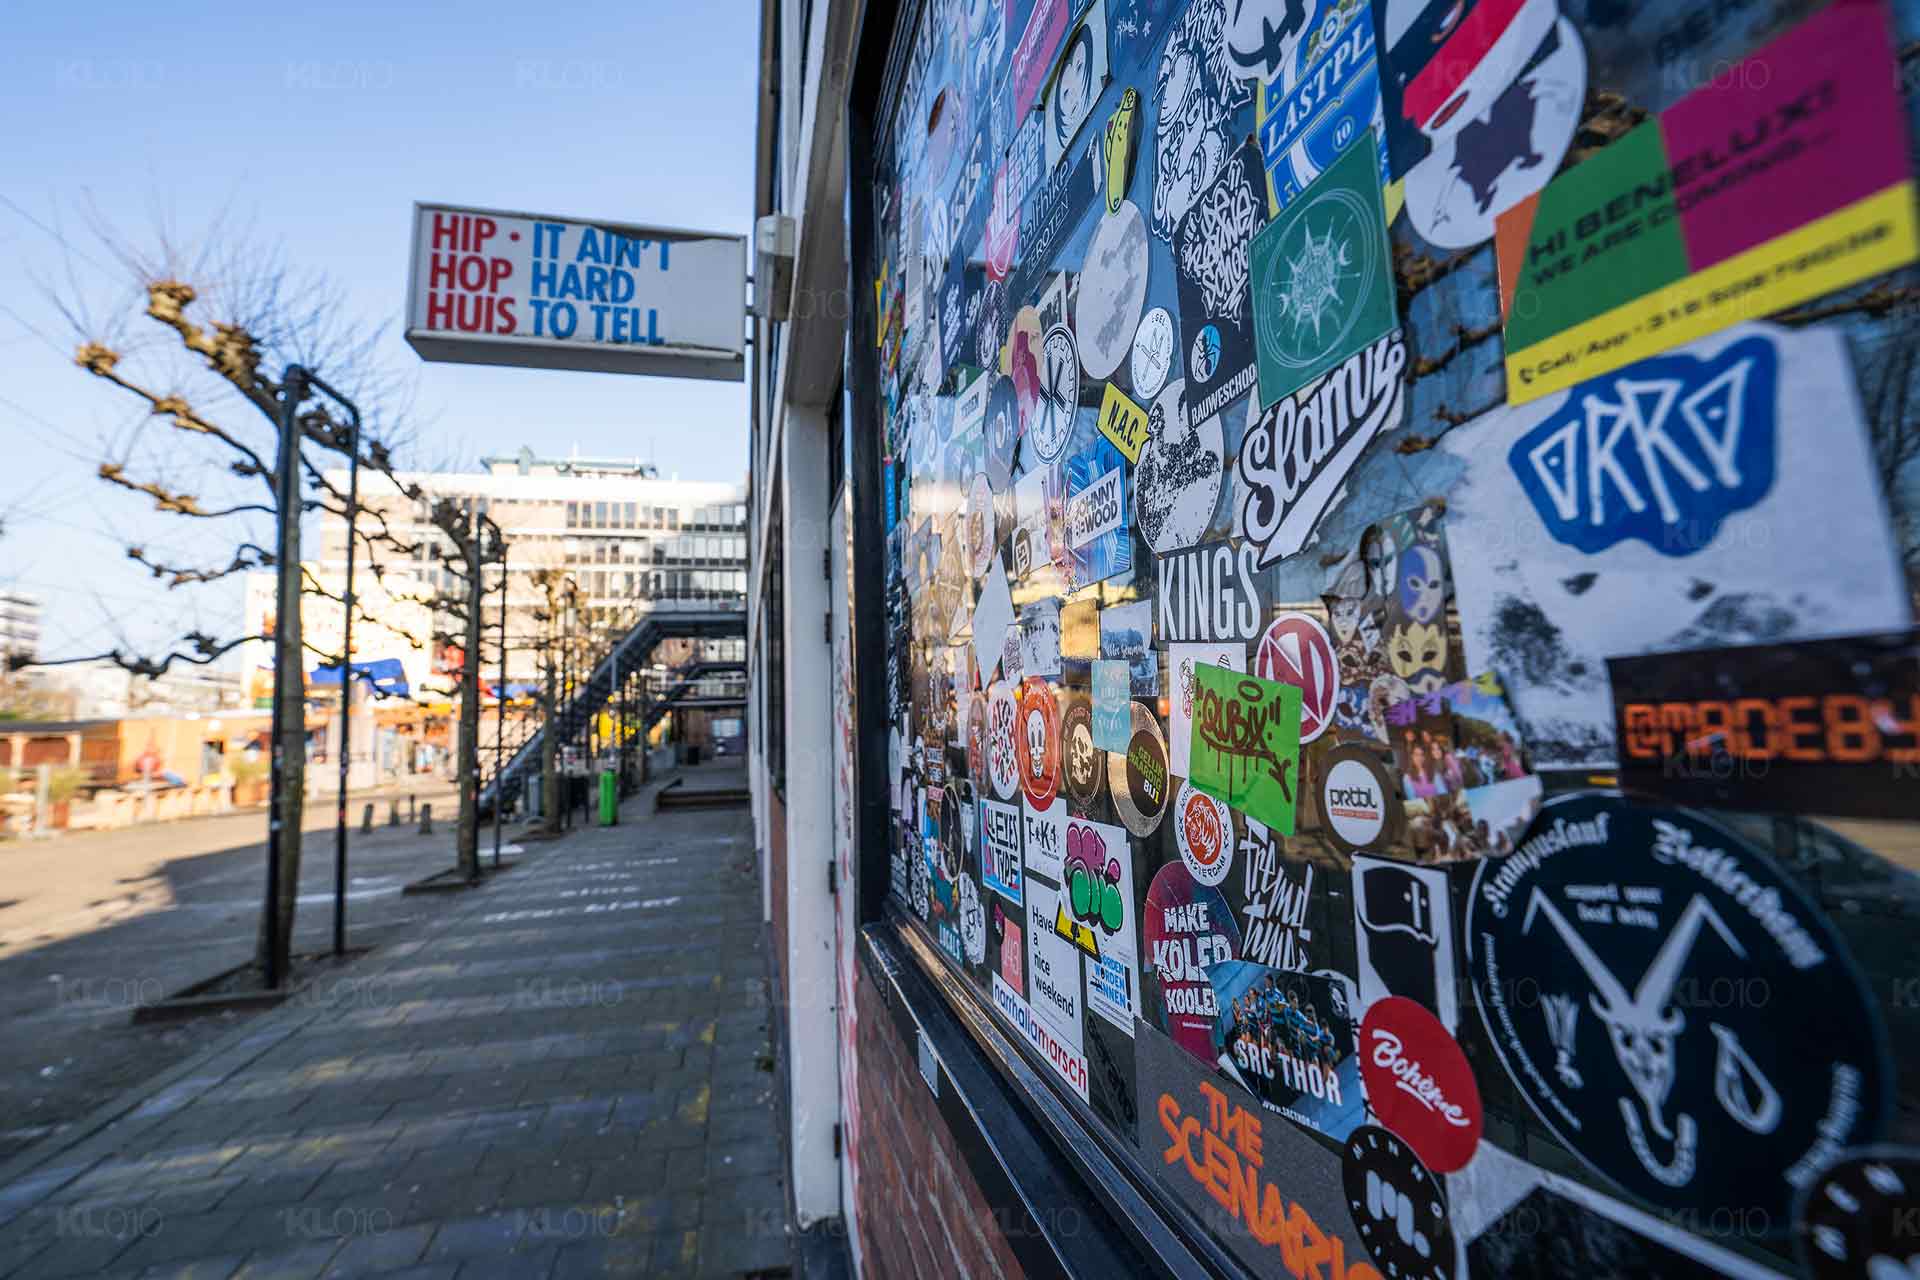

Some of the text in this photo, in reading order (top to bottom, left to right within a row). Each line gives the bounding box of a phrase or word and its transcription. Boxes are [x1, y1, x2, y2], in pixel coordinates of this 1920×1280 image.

[1267, 23, 1376, 157] LASTPL
[432, 213, 497, 253] HIP
[532, 221, 566, 261] IT
[1529, 229, 1565, 266] HI
[429, 252, 514, 293] HOP
[530, 261, 636, 304] HARD
[426, 291, 518, 335] HUIS
[529, 299, 665, 346] TO TELL
[1190, 361, 1259, 427] RAUWESCHOO
[1158, 541, 1262, 641] KINGS
[1031, 904, 1054, 935] Have
[1033, 932, 1039, 946] a
[1164, 902, 1210, 934] MAKE
[1034, 950, 1051, 977] nice
[1034, 974, 1075, 1020] weekend
[1233, 1038, 1343, 1107] SRC THOR
[1199, 1080, 1264, 1169] THE
[1158, 1092, 1384, 1280] SCENARI
